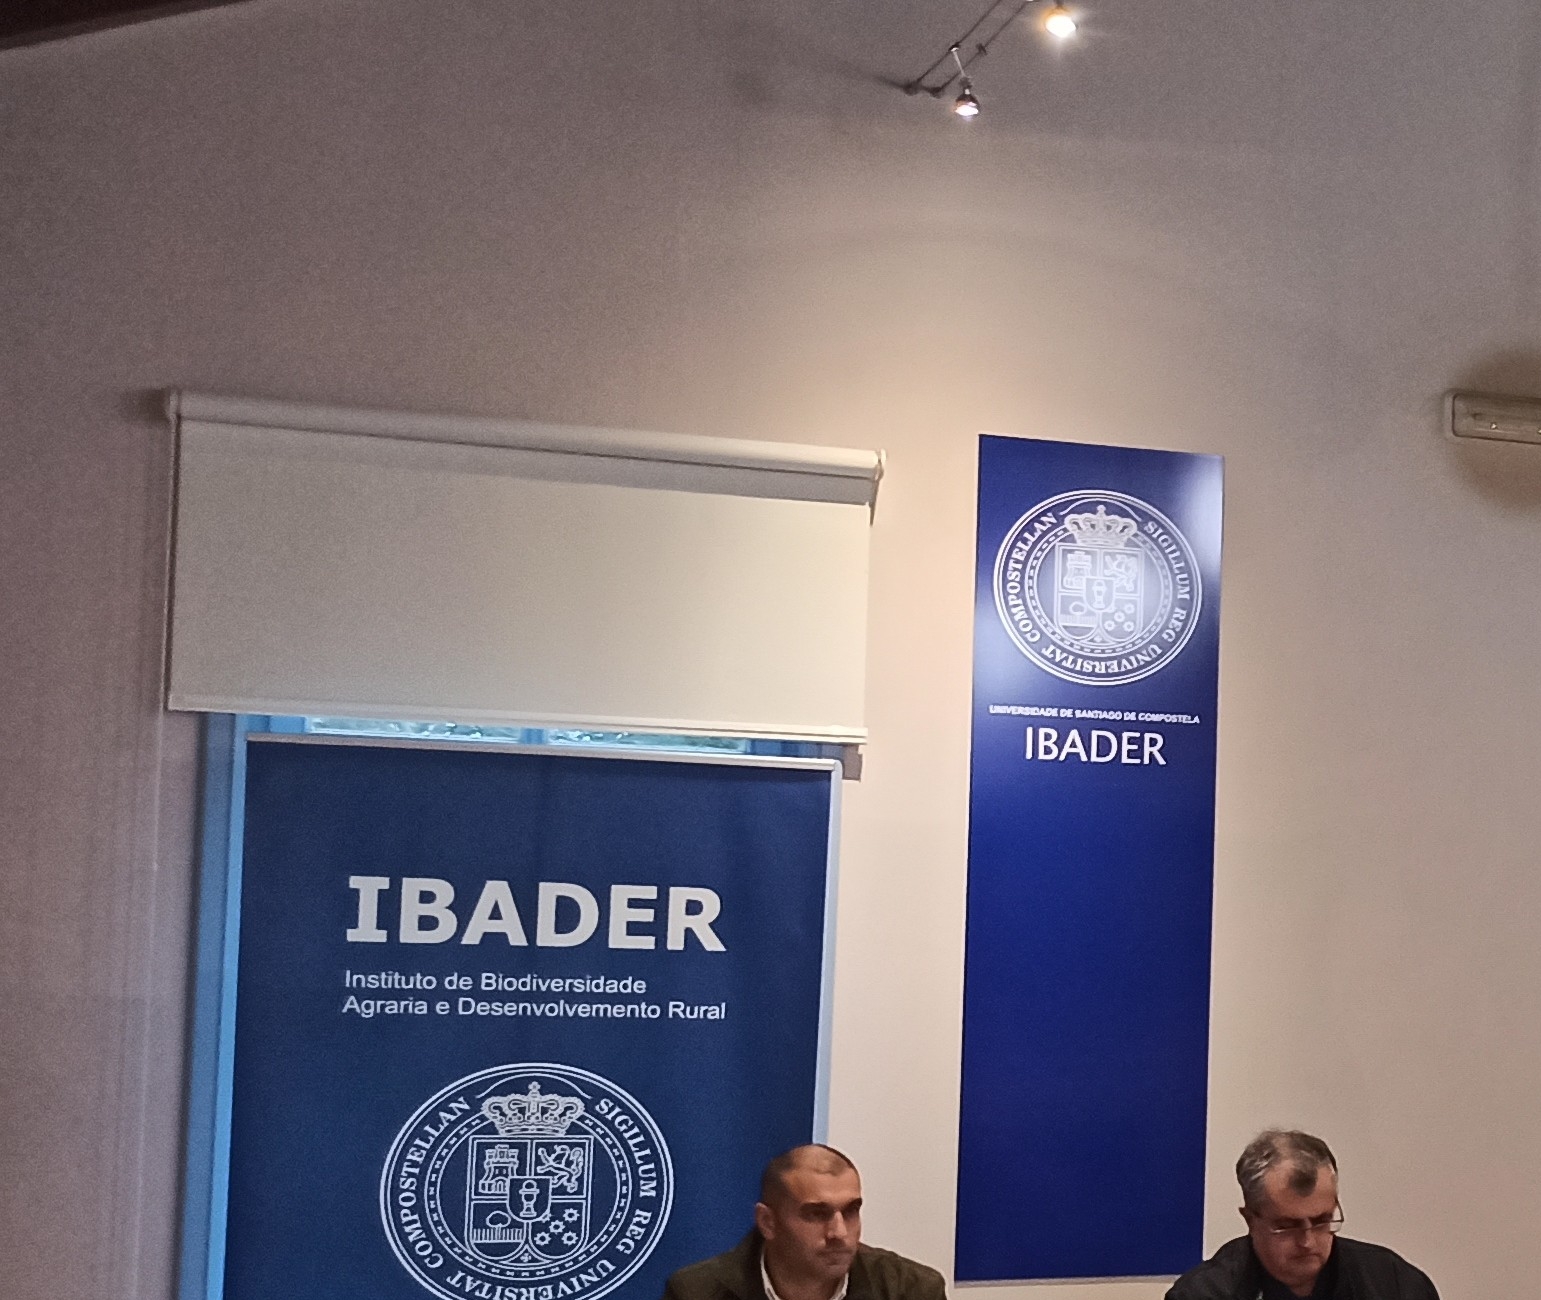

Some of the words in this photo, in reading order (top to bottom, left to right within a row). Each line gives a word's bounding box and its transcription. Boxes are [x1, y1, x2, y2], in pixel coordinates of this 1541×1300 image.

[989, 705, 1058, 717] UNIVERSIDADE
[1059, 708, 1074, 718] DE
[1075, 709, 1122, 721] SANTIAGO
[1123, 711, 1137, 721] DE
[1138, 712, 1200, 724] COMPOSTELA
[1025, 726, 1167, 765] IBADER
[346, 875, 727, 952] IBADER
[344, 970, 437, 990] Instituto
[444, 972, 473, 990] de
[480, 972, 647, 994] Biodiversidade
[342, 996, 427, 1019] Agraria
[435, 1002, 450, 1016] e
[458, 998, 661, 1019] Desenvolvemento
[668, 1001, 727, 1020] Rural
[595, 1098, 657, 1198] SIGILLUM
[398, 1096, 472, 1269] COMPOSTELLAN
[615, 1208, 653, 1256] REG
